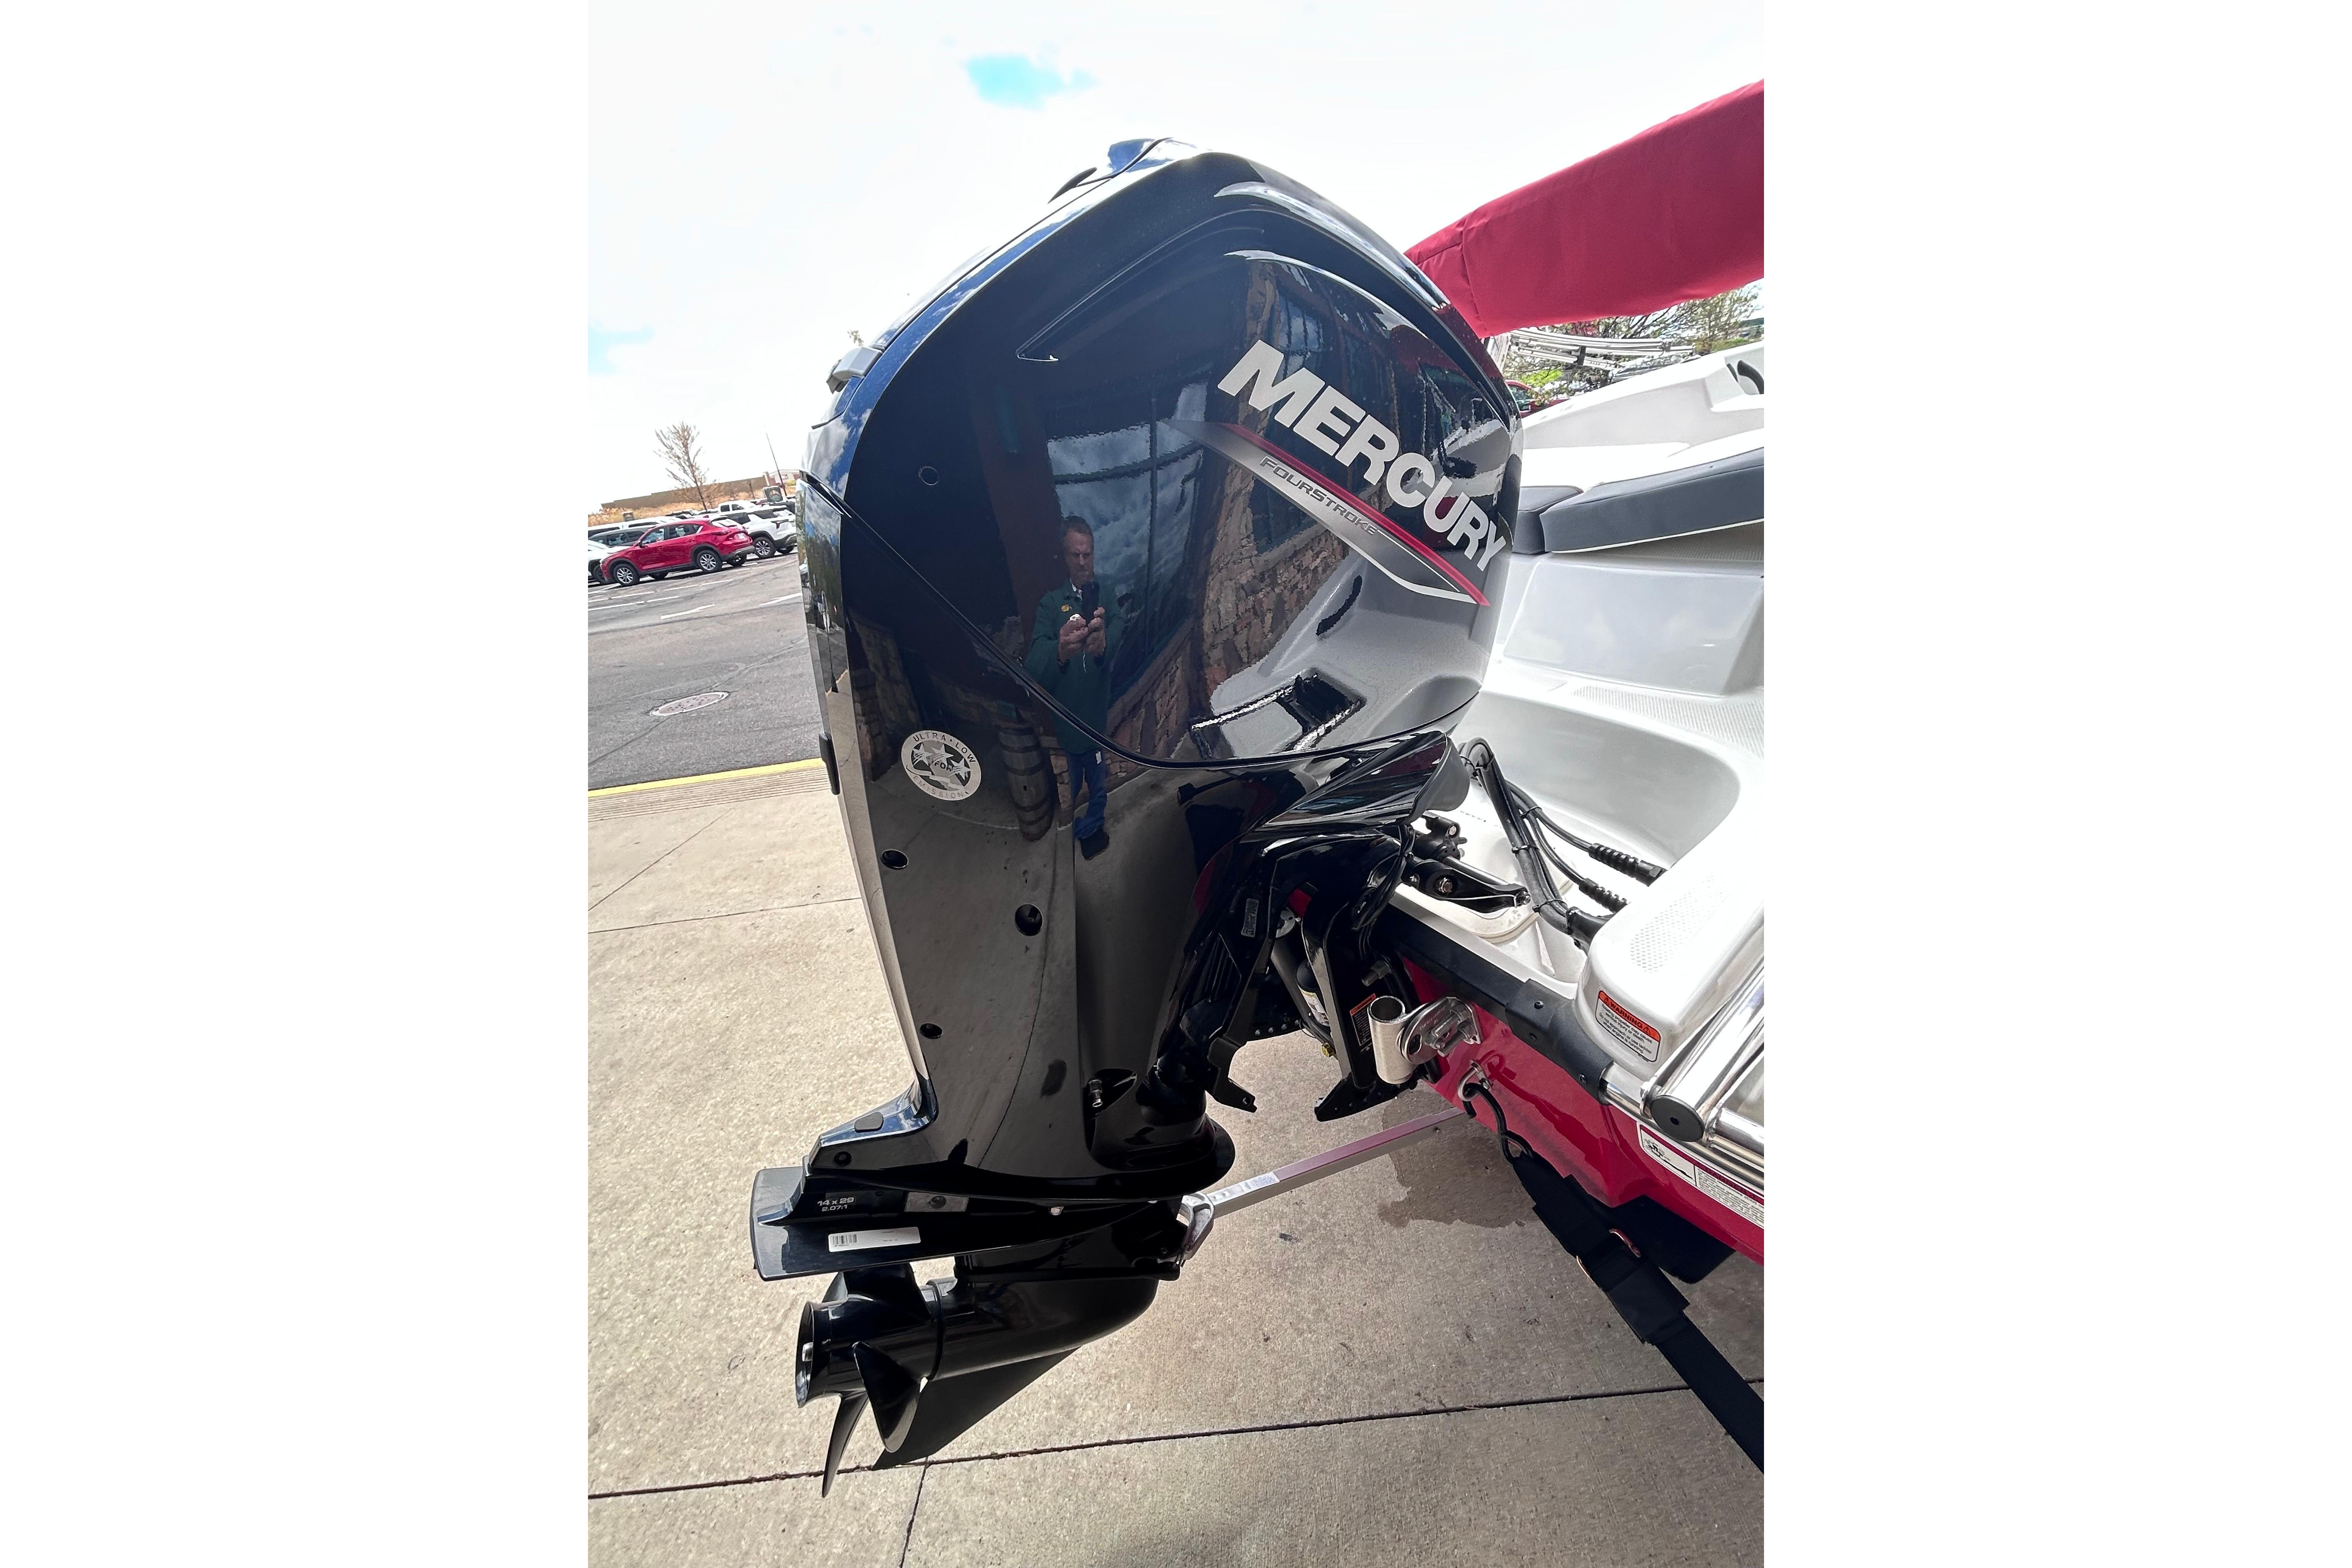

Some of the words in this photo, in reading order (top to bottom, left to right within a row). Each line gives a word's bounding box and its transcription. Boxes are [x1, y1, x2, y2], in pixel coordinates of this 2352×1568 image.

[1217, 339, 1506, 572] MERCURY
[1259, 456, 1378, 535] FOURSTROKE
[913, 732, 946, 742] ULTRA
[955, 742, 976, 763] LOW
[913, 775, 964, 798] EMISSION
[1610, 1002, 1643, 1029] WARNING
[1618, 1021, 1628, 1031] injury
[1603, 1021, 1612, 1030] when
[1612, 1029, 1624, 1039] engine
[1640, 1034, 1652, 1043] cause
